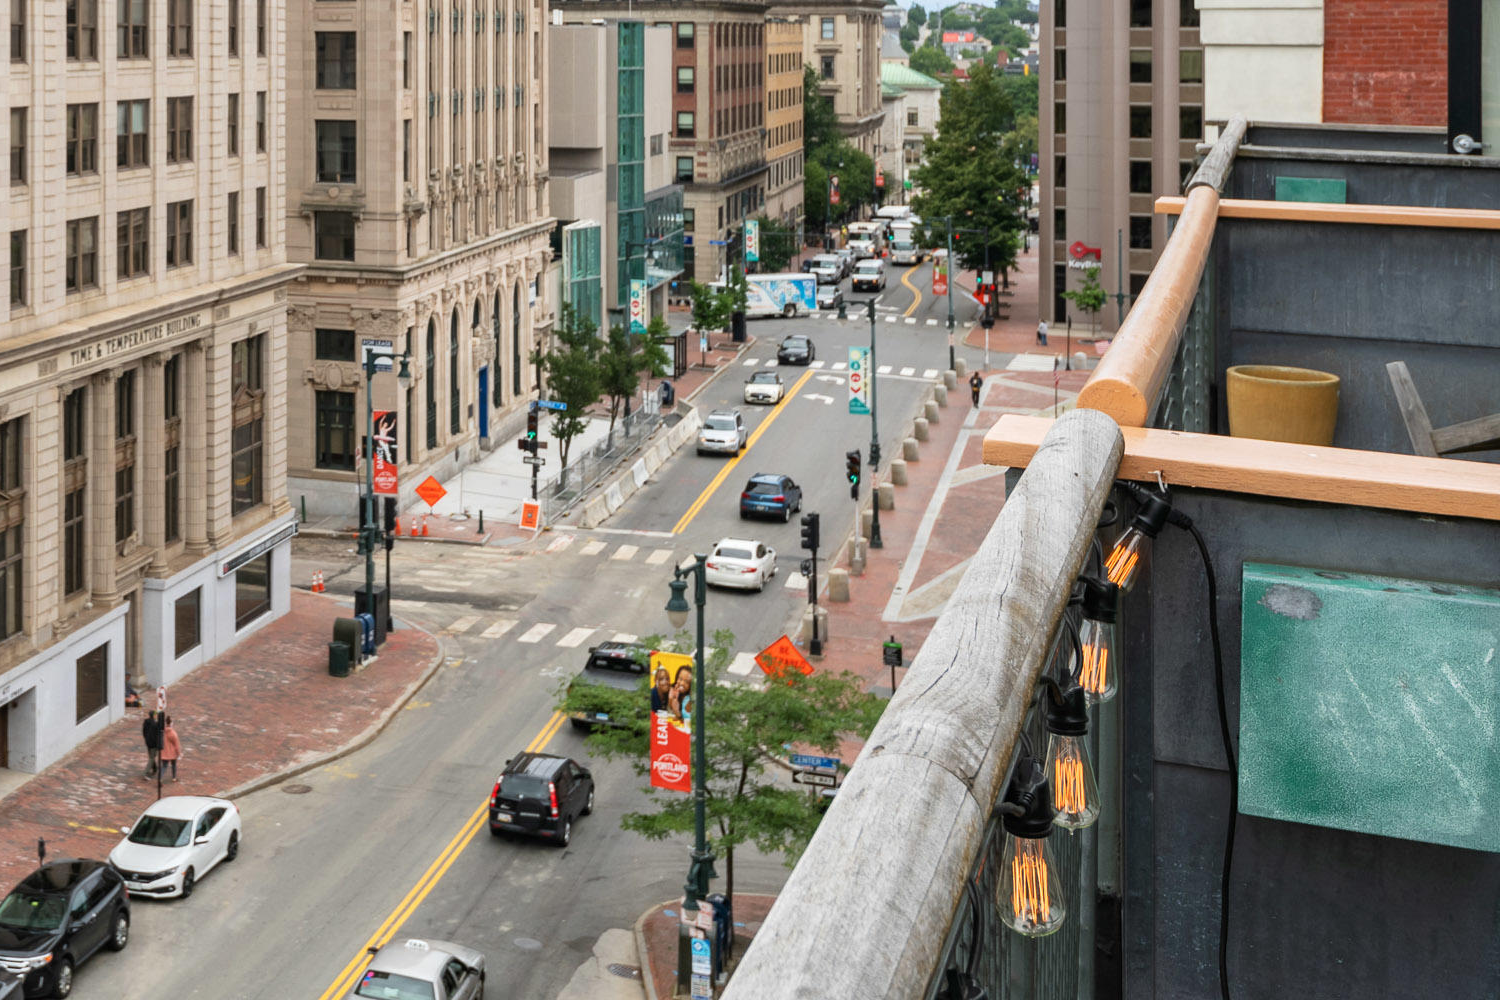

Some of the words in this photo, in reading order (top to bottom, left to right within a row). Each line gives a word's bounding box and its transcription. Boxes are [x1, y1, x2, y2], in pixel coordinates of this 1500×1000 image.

[71, 346, 92, 366] TIME
[96, 344, 102, 358] &
[106, 325, 163, 352] TEMPERATURE
[167, 314, 201, 336] BUILDING
[657, 709, 669, 745] LEARN
[653, 761, 689, 773] PORTLAND
[794, 756, 821, 766] CENTER
